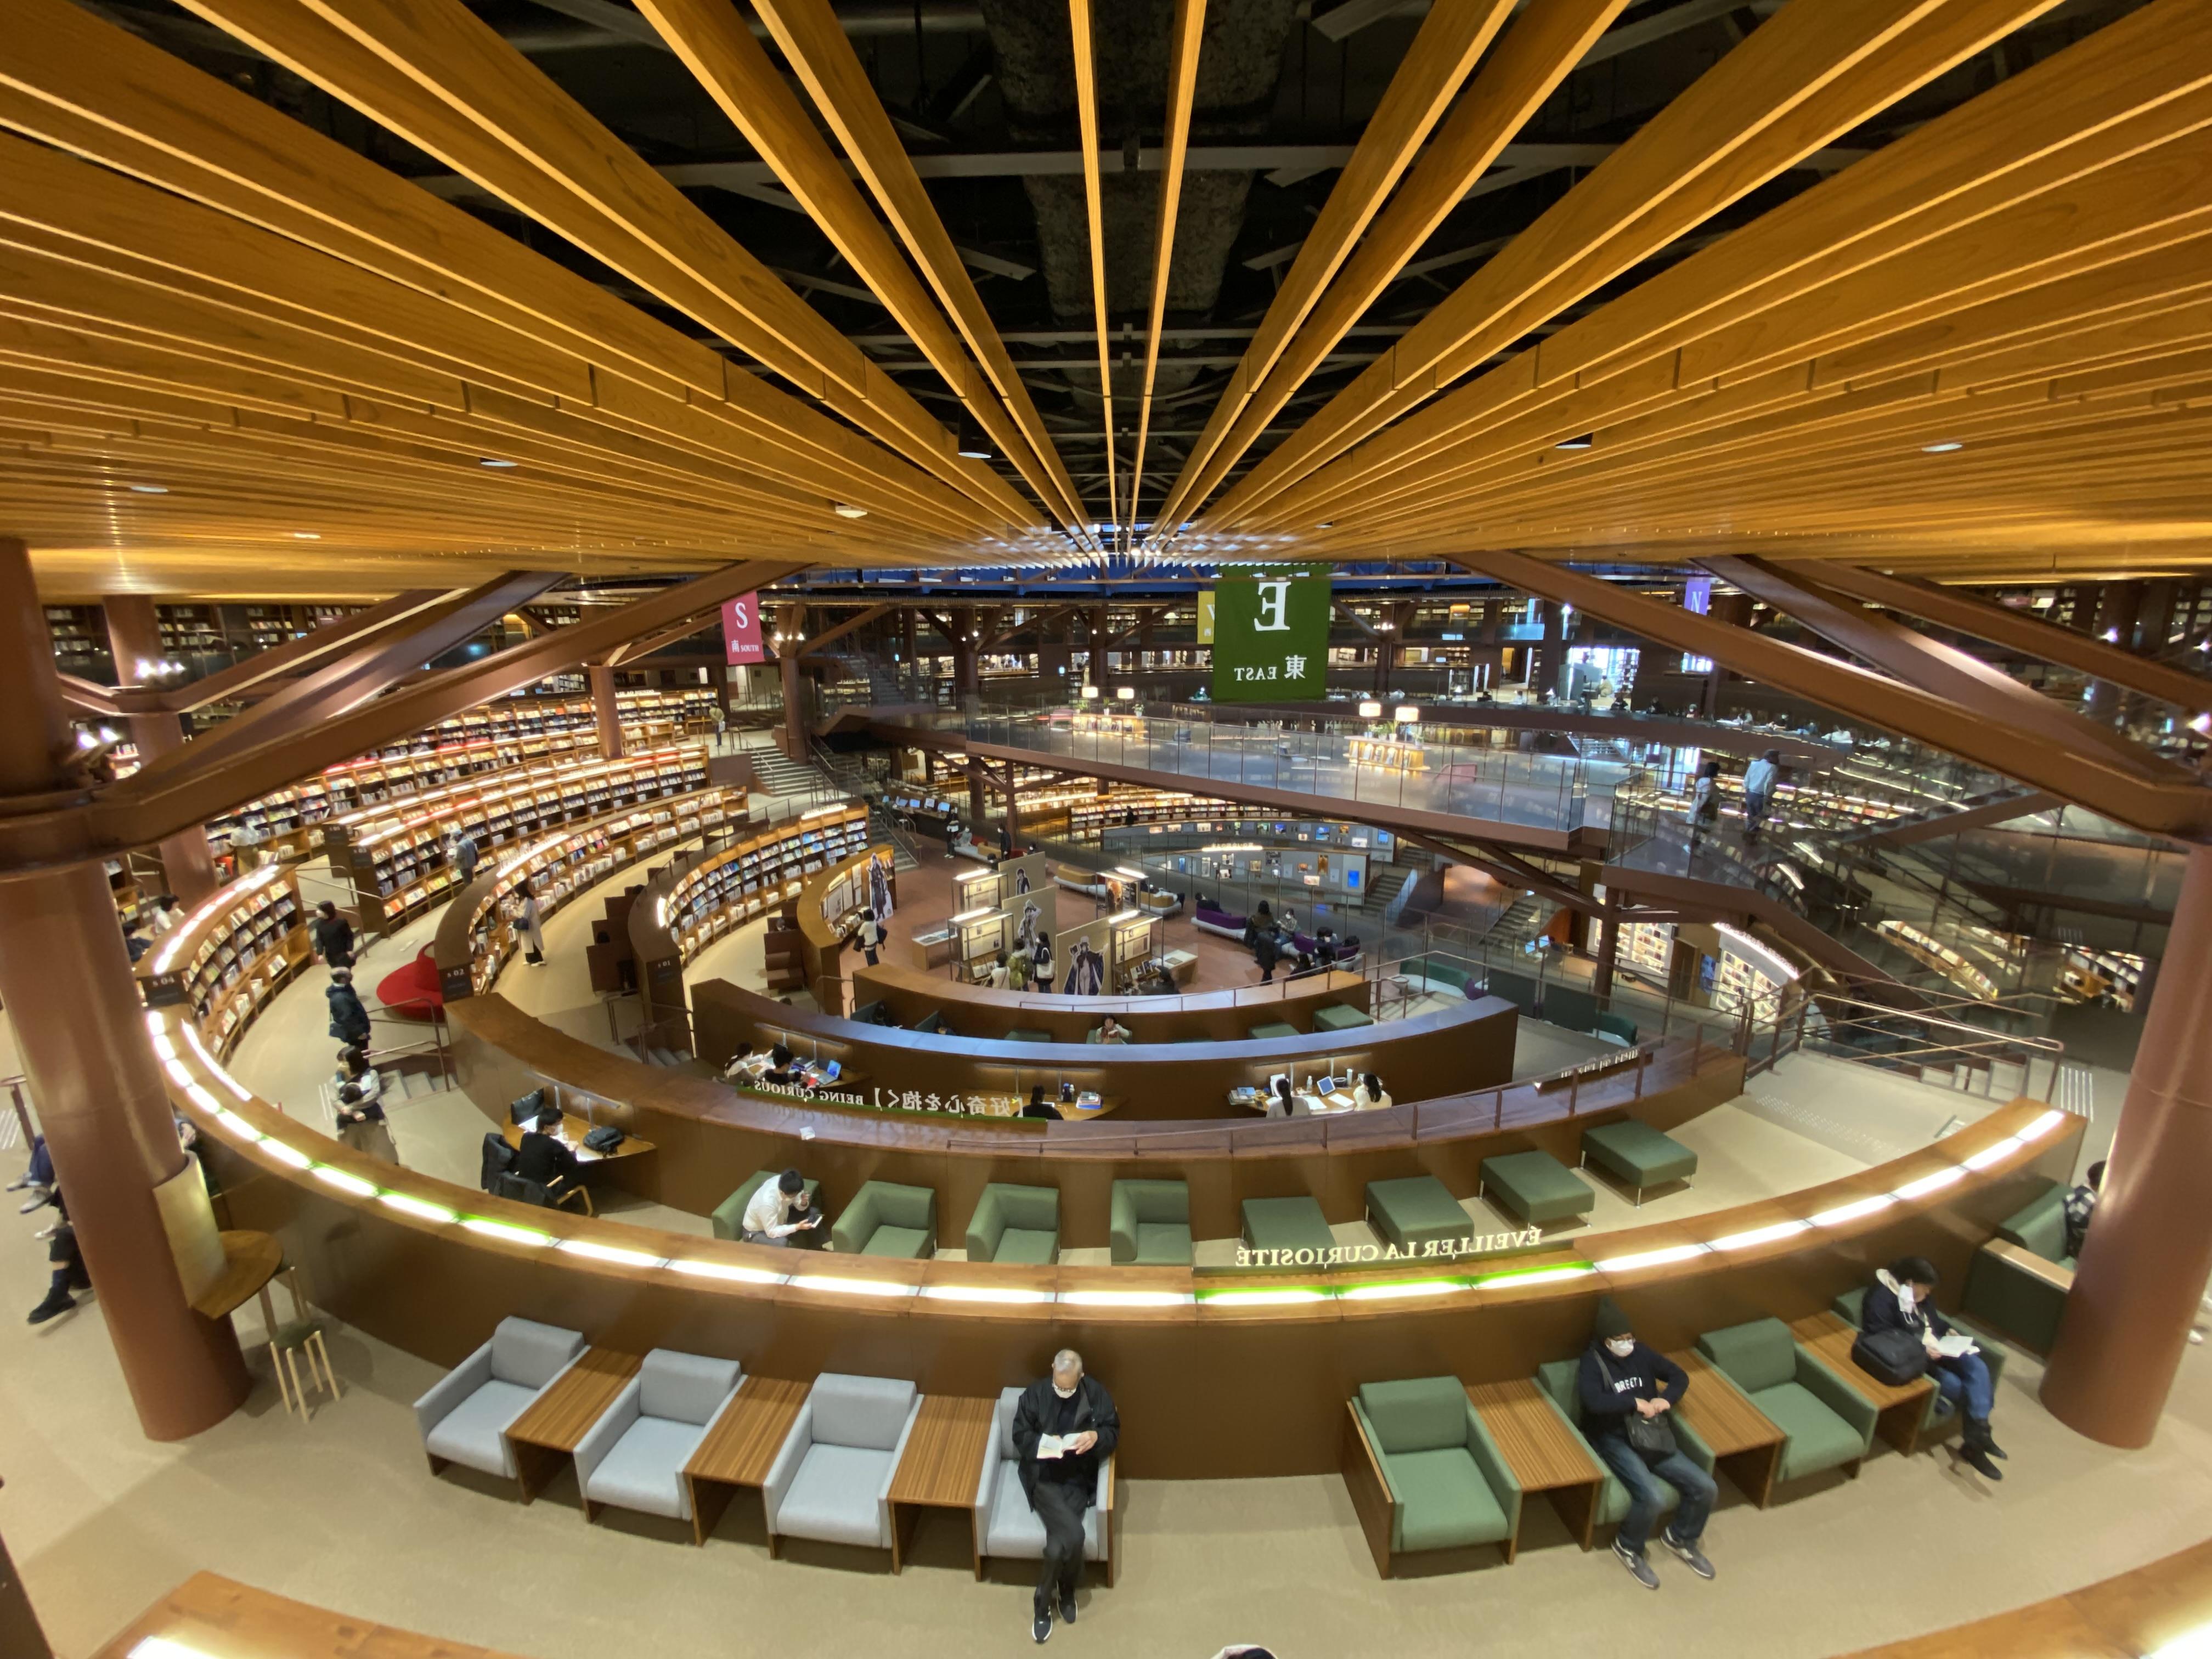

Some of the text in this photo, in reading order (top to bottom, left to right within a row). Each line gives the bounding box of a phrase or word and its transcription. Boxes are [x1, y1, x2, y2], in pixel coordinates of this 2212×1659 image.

[1691, 591, 1702, 613] N
[735, 602, 748, 629] S
[731, 640, 740, 653] 南
